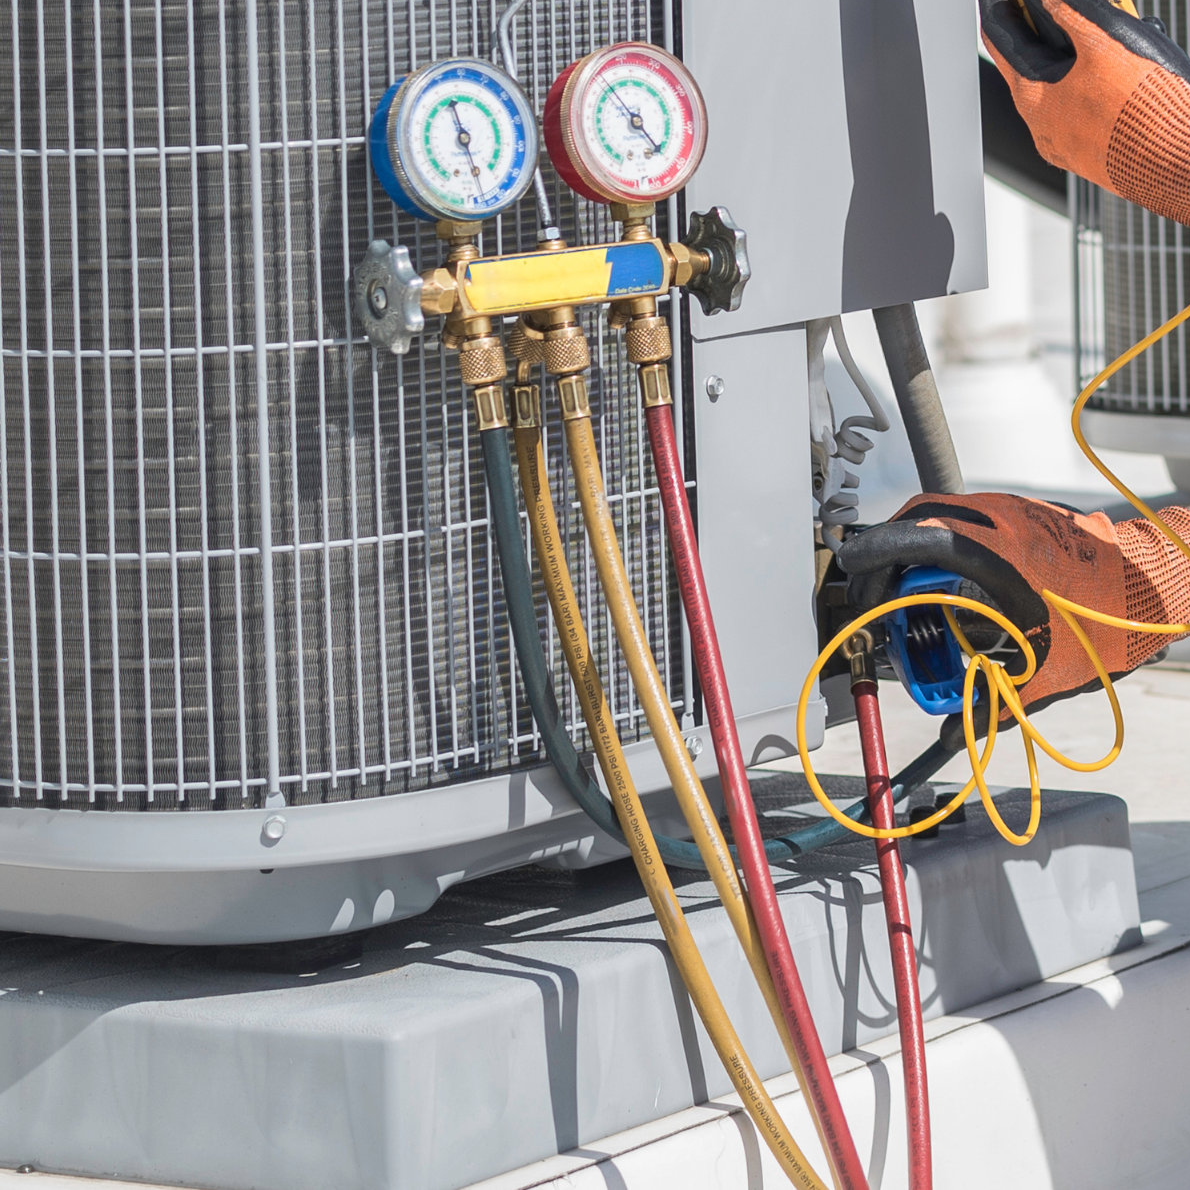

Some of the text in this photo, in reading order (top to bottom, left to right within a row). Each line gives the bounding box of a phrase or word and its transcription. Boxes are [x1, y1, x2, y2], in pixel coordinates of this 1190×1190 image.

[648, 58, 661, 70] 300
[480, 73, 490, 83] 70
[499, 90, 510, 101] 80
[513, 114, 522, 125] 90
[686, 120, 694, 135] 400
[676, 157, 686, 170] 450
[649, 181, 662, 189] 500
[525, 444, 543, 502] PRESSURE
[665, 491, 676, 508] PSI
[535, 503, 554, 553] WORKING
[672, 527, 686, 560] BURST
[546, 553, 568, 601] MAXIMUM
[560, 600, 575, 626] BAR)
[688, 606, 699, 622] PSI
[567, 626, 579, 643] (34
[692, 623, 704, 646] 2500
[572, 643, 584, 660] PSI
[697, 646, 710, 674] HOSE
[577, 659, 590, 677] 500
[583, 677, 600, 710] BURST
[703, 675, 722, 728] CHARGING
[592, 709, 607, 734] BAR)
[600, 733, 614, 754] (172
[607, 752, 620, 769] PSI
[613, 769, 627, 791] 2500
[619, 791, 636, 817] HOSE
[629, 816, 653, 866] CHARGING
[769, 949, 794, 1009] PRESSURE
[787, 1009, 811, 1063] WORKING
[727, 1053, 759, 1102] PRESSURE
[753, 1101, 782, 1141] WORKING
[775, 1139, 804, 1173] MAXIMUM
